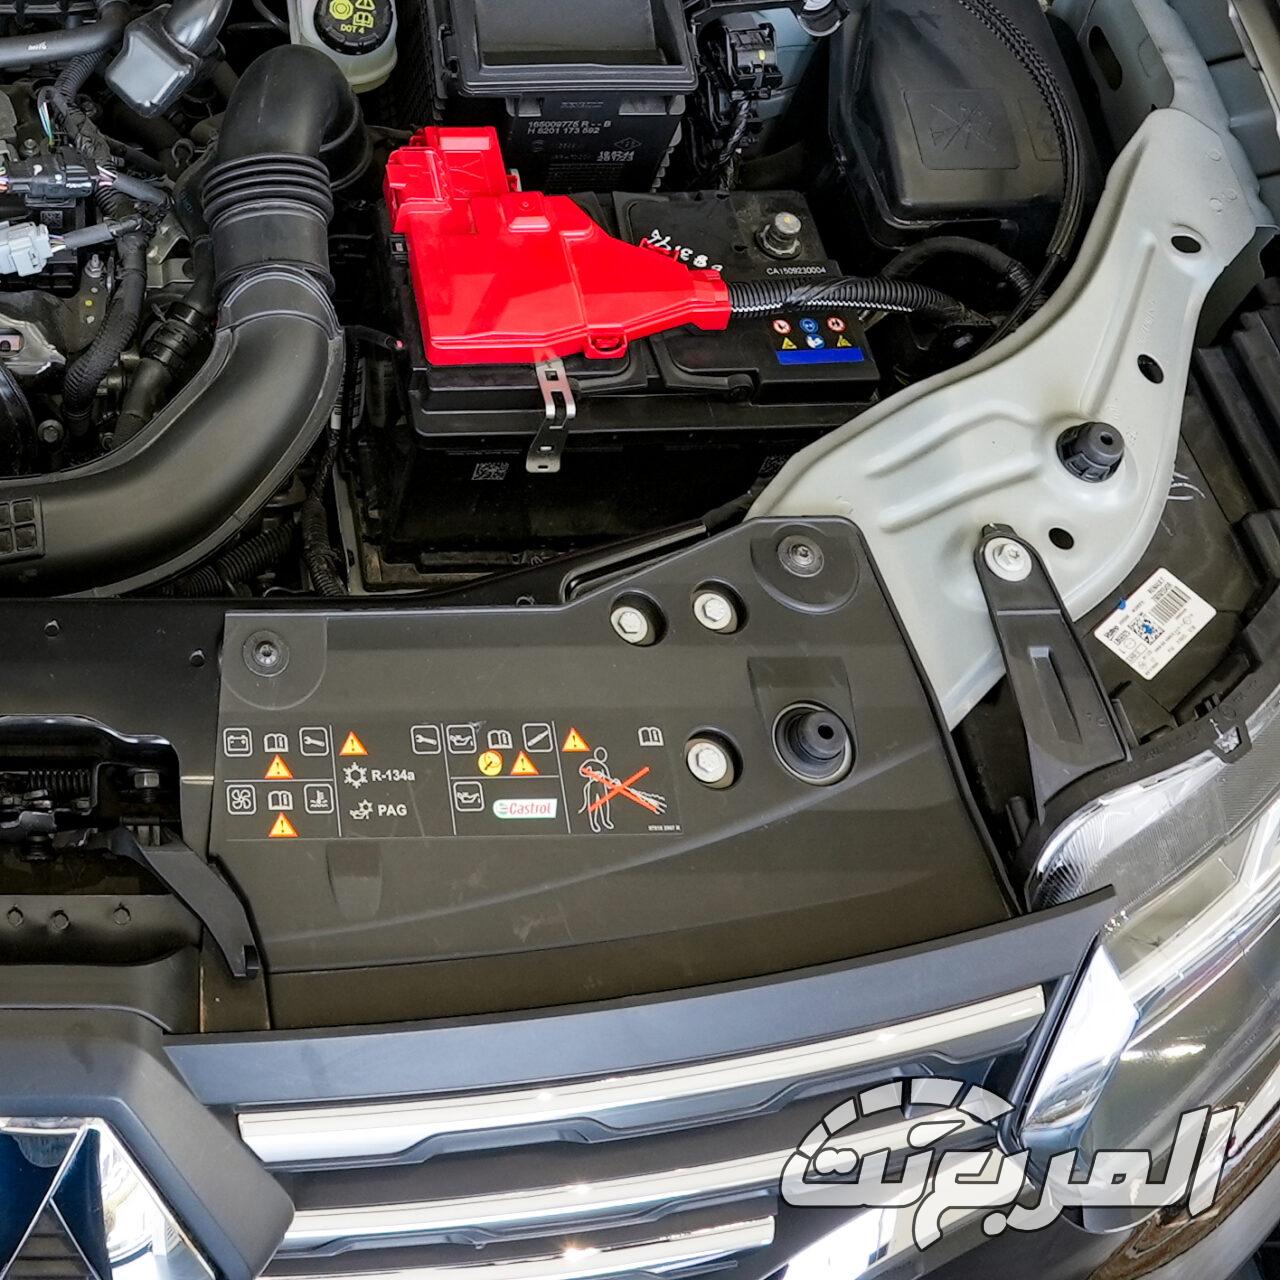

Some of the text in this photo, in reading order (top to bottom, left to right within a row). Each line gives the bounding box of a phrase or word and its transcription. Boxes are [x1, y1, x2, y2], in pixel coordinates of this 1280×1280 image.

[340, 23, 365, 34] DOT 4
[371, 769, 416, 783] R-134a
[377, 803, 408, 817] PAG
[508, 801, 552, 817] Castrol
